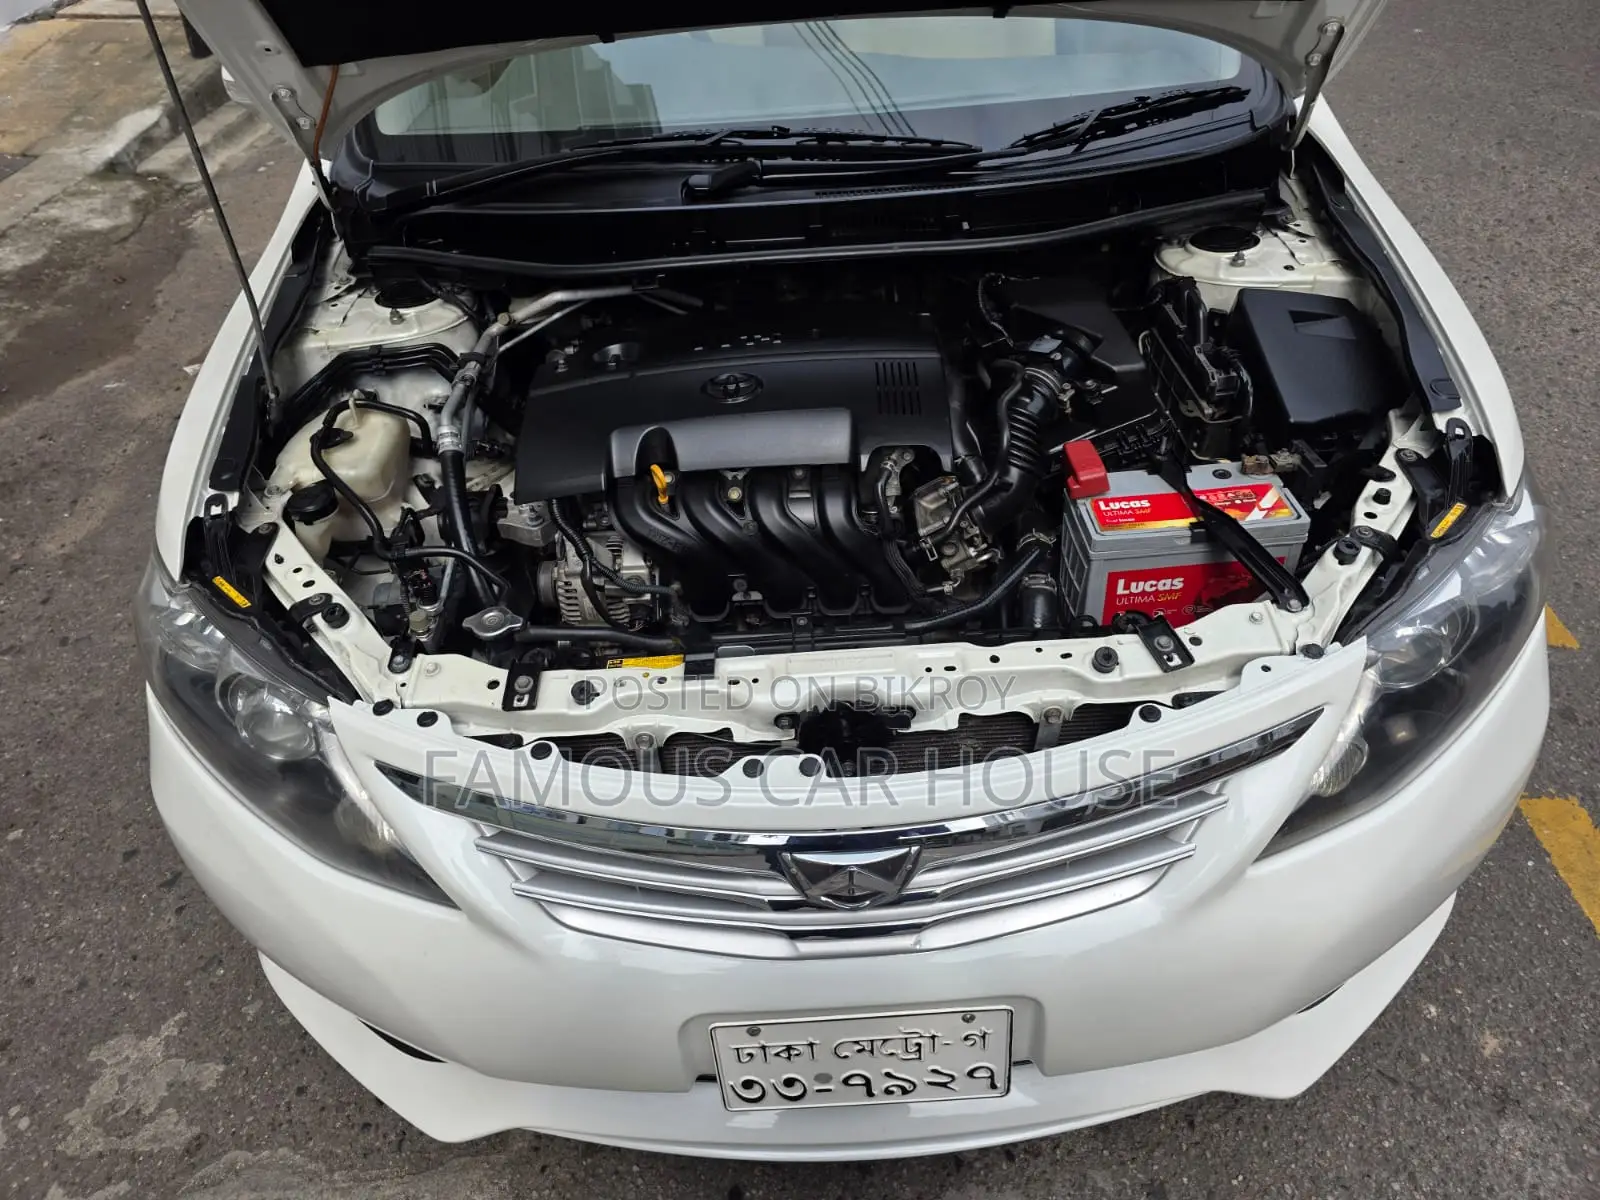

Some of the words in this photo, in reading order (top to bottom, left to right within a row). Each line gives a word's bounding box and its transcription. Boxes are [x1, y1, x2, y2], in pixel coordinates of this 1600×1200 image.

[1098, 499, 1151, 511] Lucas
[1116, 577, 1184, 595] Lucas
[1116, 595, 1155, 606] ULTIMA
[1157, 592, 1182, 602] SMF
[729, 1037, 821, 1064] ঢাকা
[729, 1064, 1000, 1104] ৩৩-৭৯২৭
